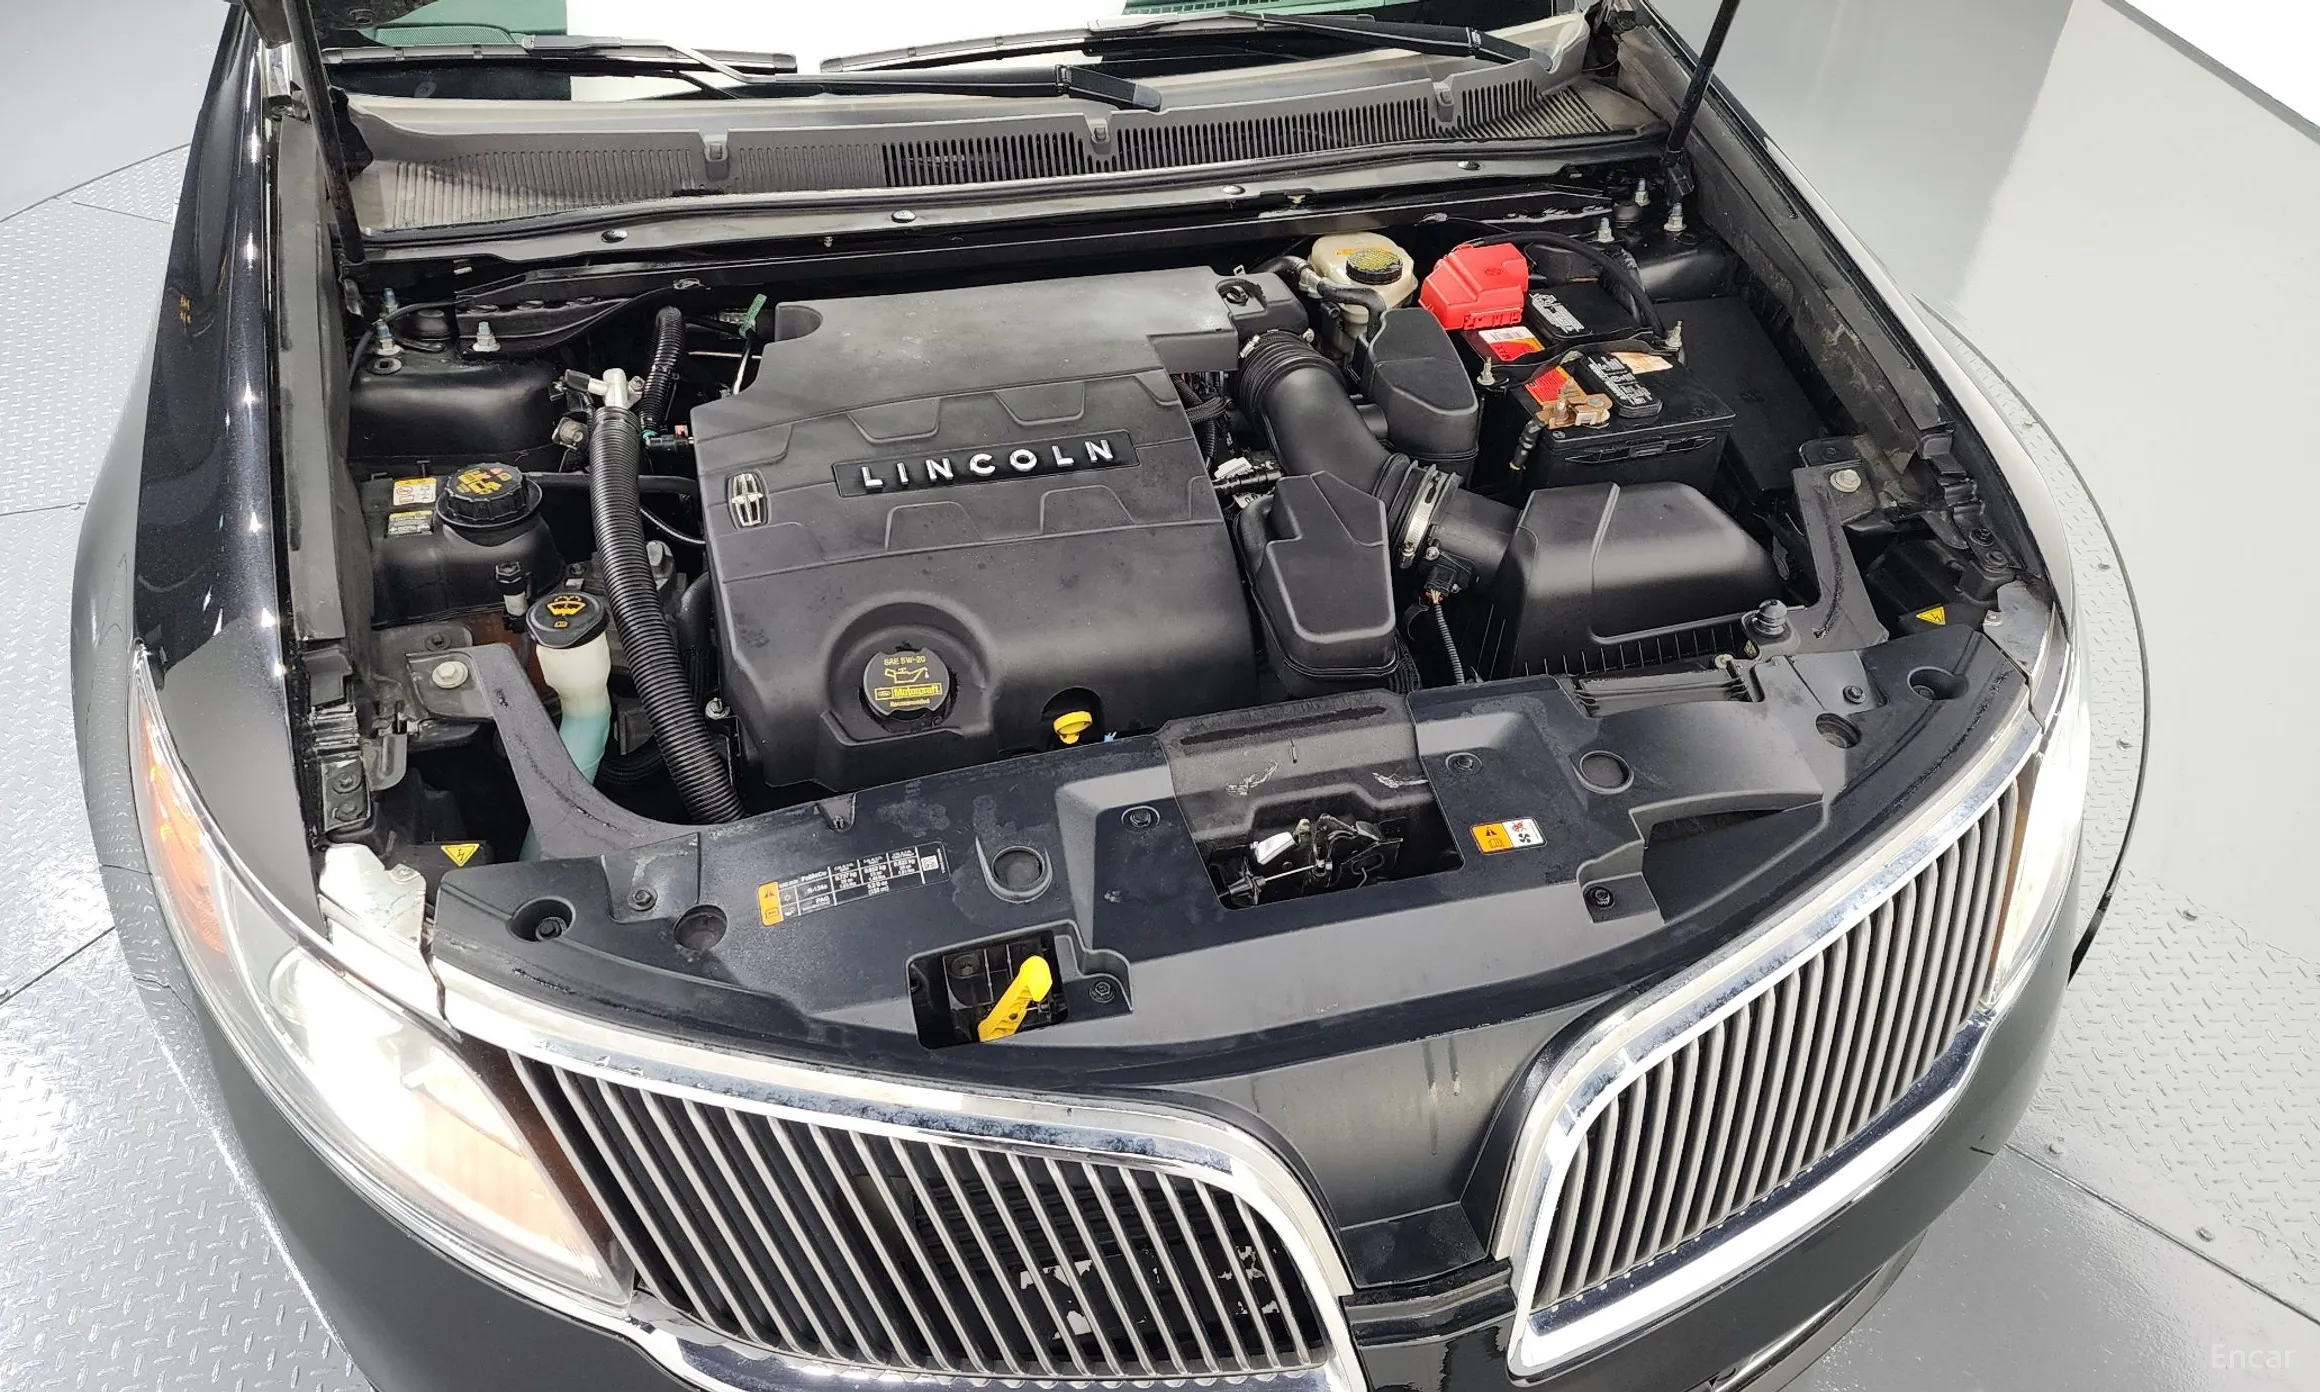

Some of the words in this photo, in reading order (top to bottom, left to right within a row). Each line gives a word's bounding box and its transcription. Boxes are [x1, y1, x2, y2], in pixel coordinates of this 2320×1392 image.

[860, 438, 1114, 489] LINCOLN
[883, 658, 900, 666] SAE
[900, 655, 926, 665] 5W-20
[894, 686, 940, 697] Motorcraft
